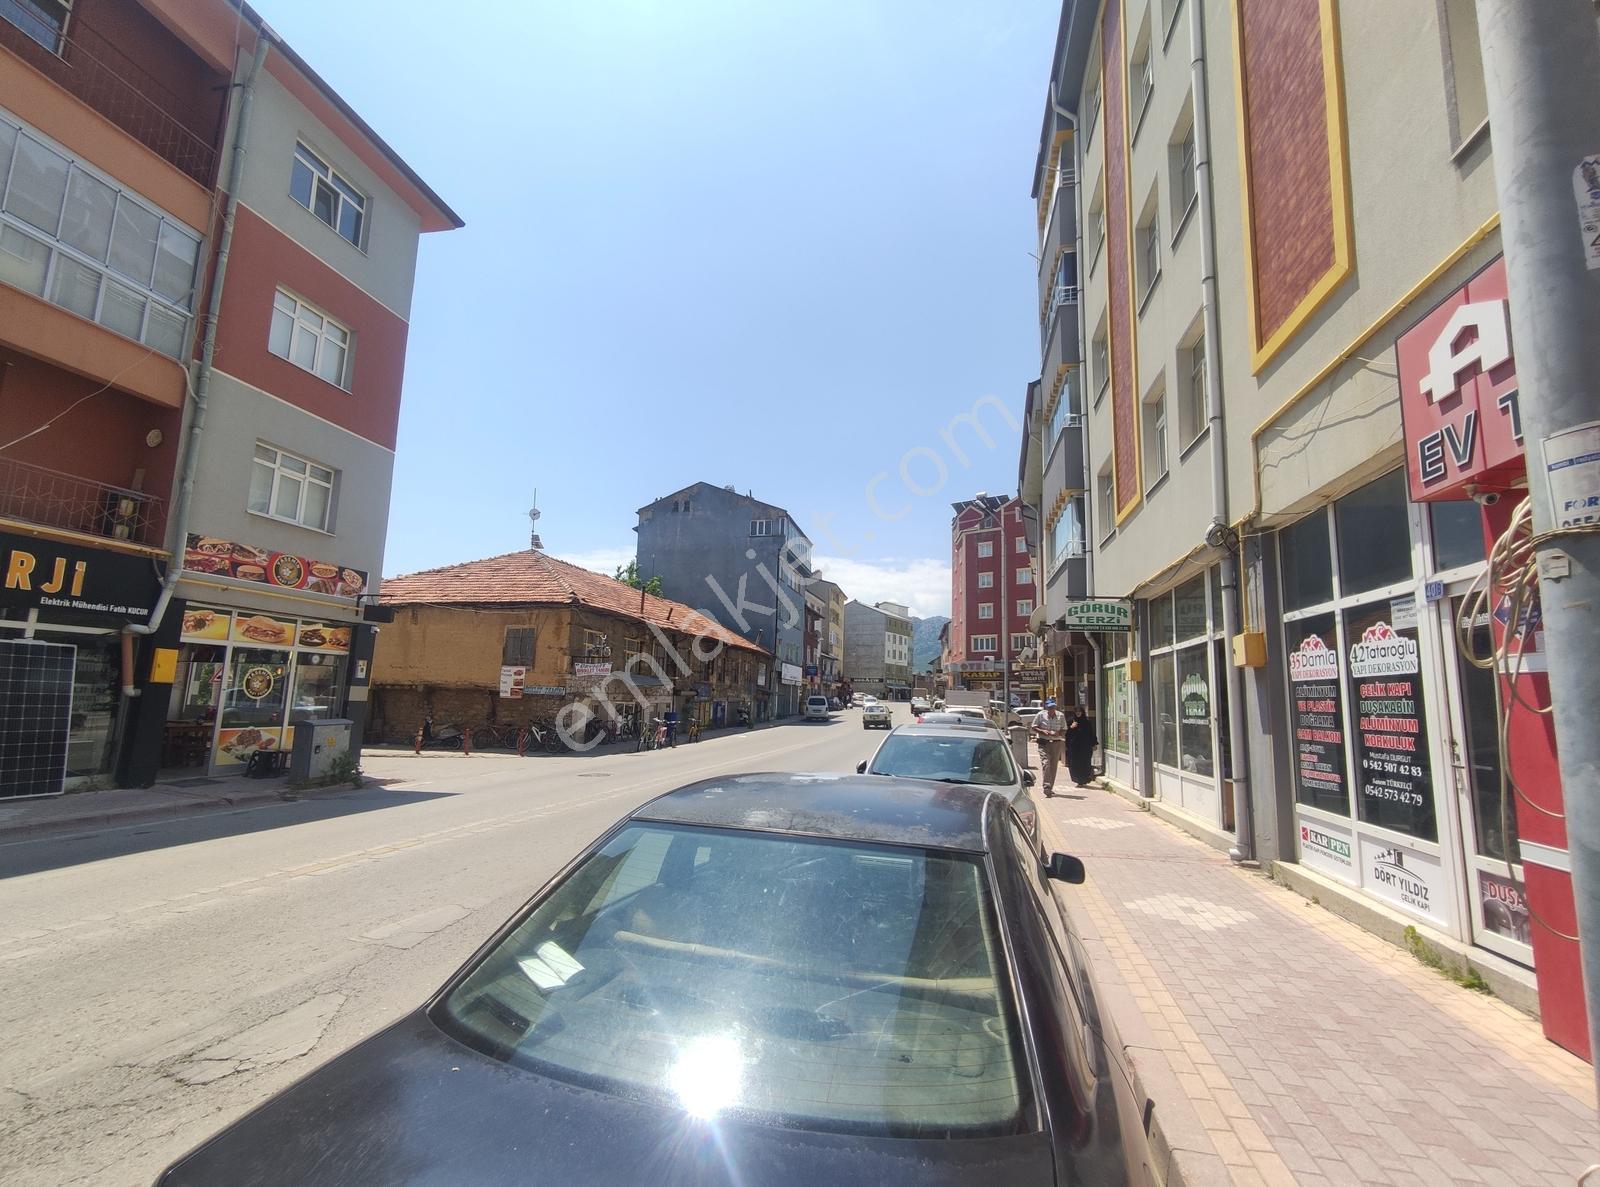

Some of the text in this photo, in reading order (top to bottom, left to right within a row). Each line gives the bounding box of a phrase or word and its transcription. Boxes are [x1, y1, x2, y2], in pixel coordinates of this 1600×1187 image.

[1419, 299, 1510, 404] A
[1418, 410, 1477, 482] EV
[40, 597, 70, 607] Elektrik
[72, 600, 109, 611] Mühendisi
[109, 605, 127, 614] Fatih
[1067, 602, 1128, 618] GÖRÜR
[1076, 616, 1121, 624] TERZİ
[1368, 660, 1416, 674] DEKORASYON
[1296, 684, 1336, 697] ALÜMİNYUM
[1360, 681, 1412, 698] ÇELİK KAPI
[1307, 699, 1336, 712] PLASTİK
[1360, 698, 1415, 715] DUŞAKABİN
[1300, 713, 1334, 727] DOĞRAMA
[1360, 715, 1418, 733] ALÜMİNYUM
[1364, 734, 1415, 751] KORKULUK
[1363, 759, 1422, 776] 0 542 507 42 83
[1365, 784, 1423, 806] 0542 573 42 79
[1374, 865, 1429, 901] DÖRT YILDIZ
